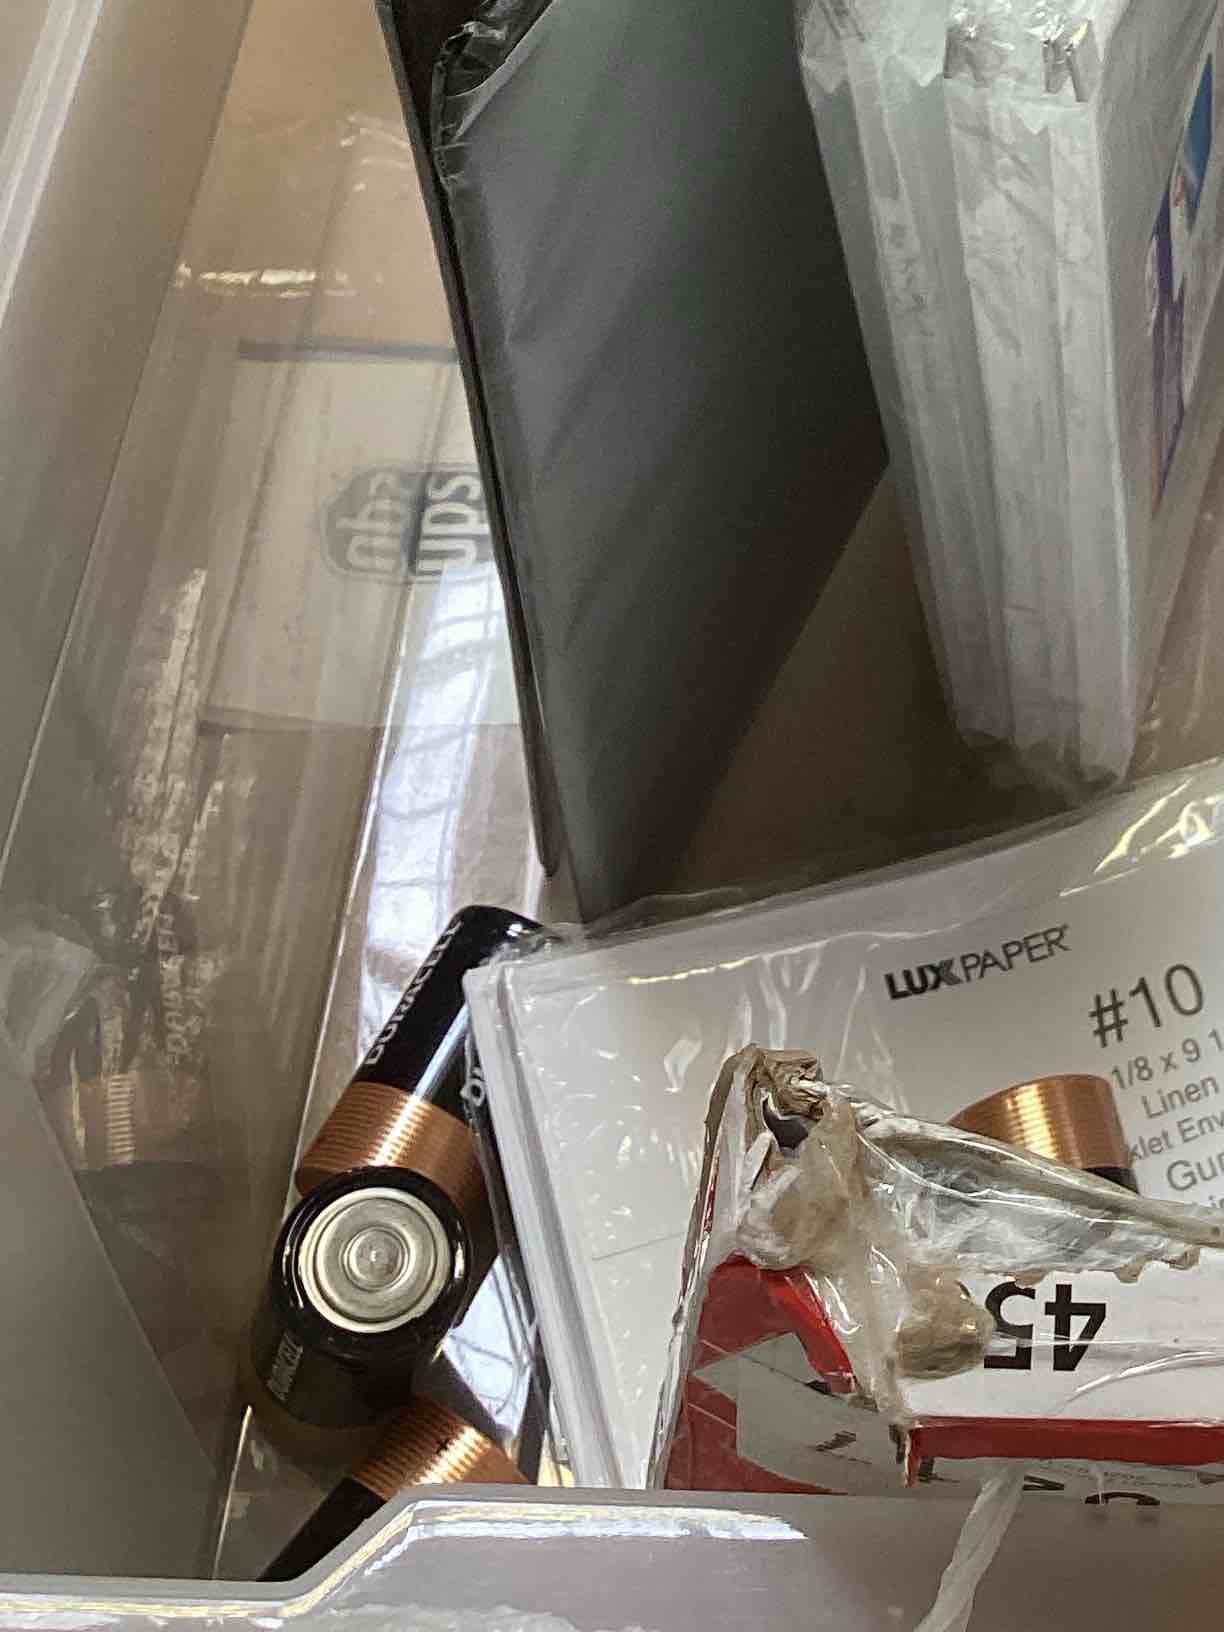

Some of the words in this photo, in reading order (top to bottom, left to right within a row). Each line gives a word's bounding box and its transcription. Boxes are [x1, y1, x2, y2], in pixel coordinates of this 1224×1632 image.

[1088, 963, 1204, 1049] #10
[1160, 1050, 1179, 1073] x
[1181, 1037, 1201, 1063] 9
[1141, 1074, 1220, 1119] Linen
[984, 1280, 1106, 1372] 45
